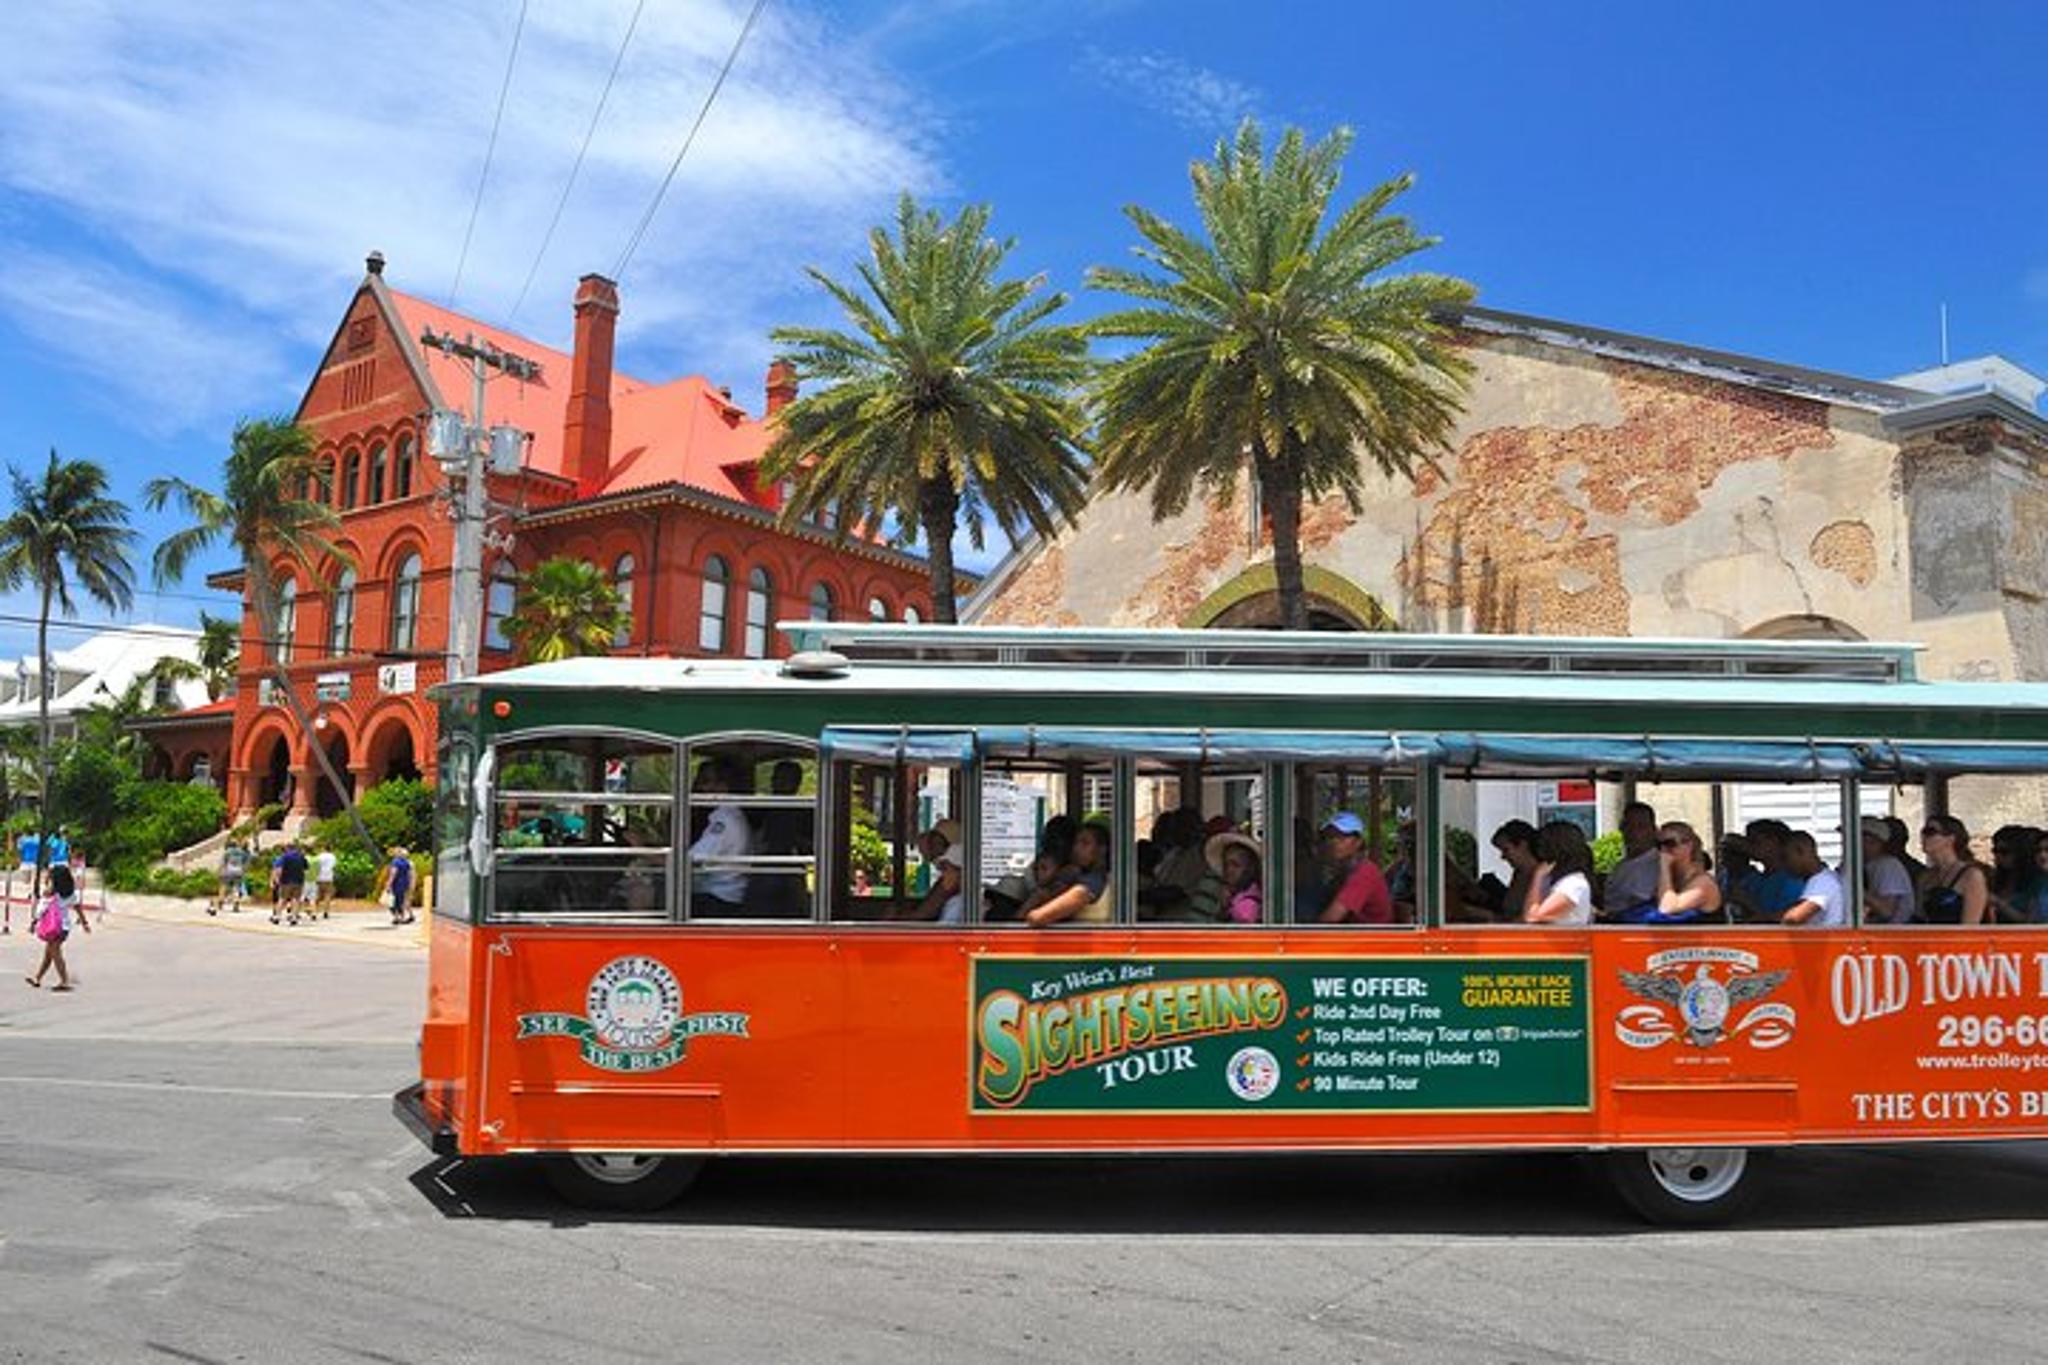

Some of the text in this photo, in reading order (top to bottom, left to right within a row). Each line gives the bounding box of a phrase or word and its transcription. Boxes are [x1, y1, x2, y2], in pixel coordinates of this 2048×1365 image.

[1031, 964, 1155, 1000] Key West's Best
[1312, 977, 1428, 997] WE OFFER:
[1831, 954, 1910, 1026] OLD
[1917, 952, 2022, 1005] TOWN
[1461, 988, 1572, 1008] GUARANTEE
[529, 1015, 570, 1032] SEE
[1313, 1004, 1441, 1023] Ride 2nd Day Free
[686, 1015, 742, 1033] FIRST
[980, 979, 1285, 1104] SIGHTSEEING
[1314, 1028, 1339, 1047] Top
[1342, 1027, 1385, 1043] Rated
[1388, 1026, 1433, 1046] Trolley
[1437, 1026, 1469, 1042] Tour
[1473, 1029, 1494, 1042] on
[590, 1048, 682, 1070] THE BEST
[1096, 1045, 1197, 1090] TOUR
[1313, 1050, 1500, 1068] Kids Ride Free (Under 12)
[1313, 1075, 1419, 1091] 90 Minute Tour
[1852, 1093, 1914, 1120] THE
[1921, 1088, 2010, 1119] CITY'S
